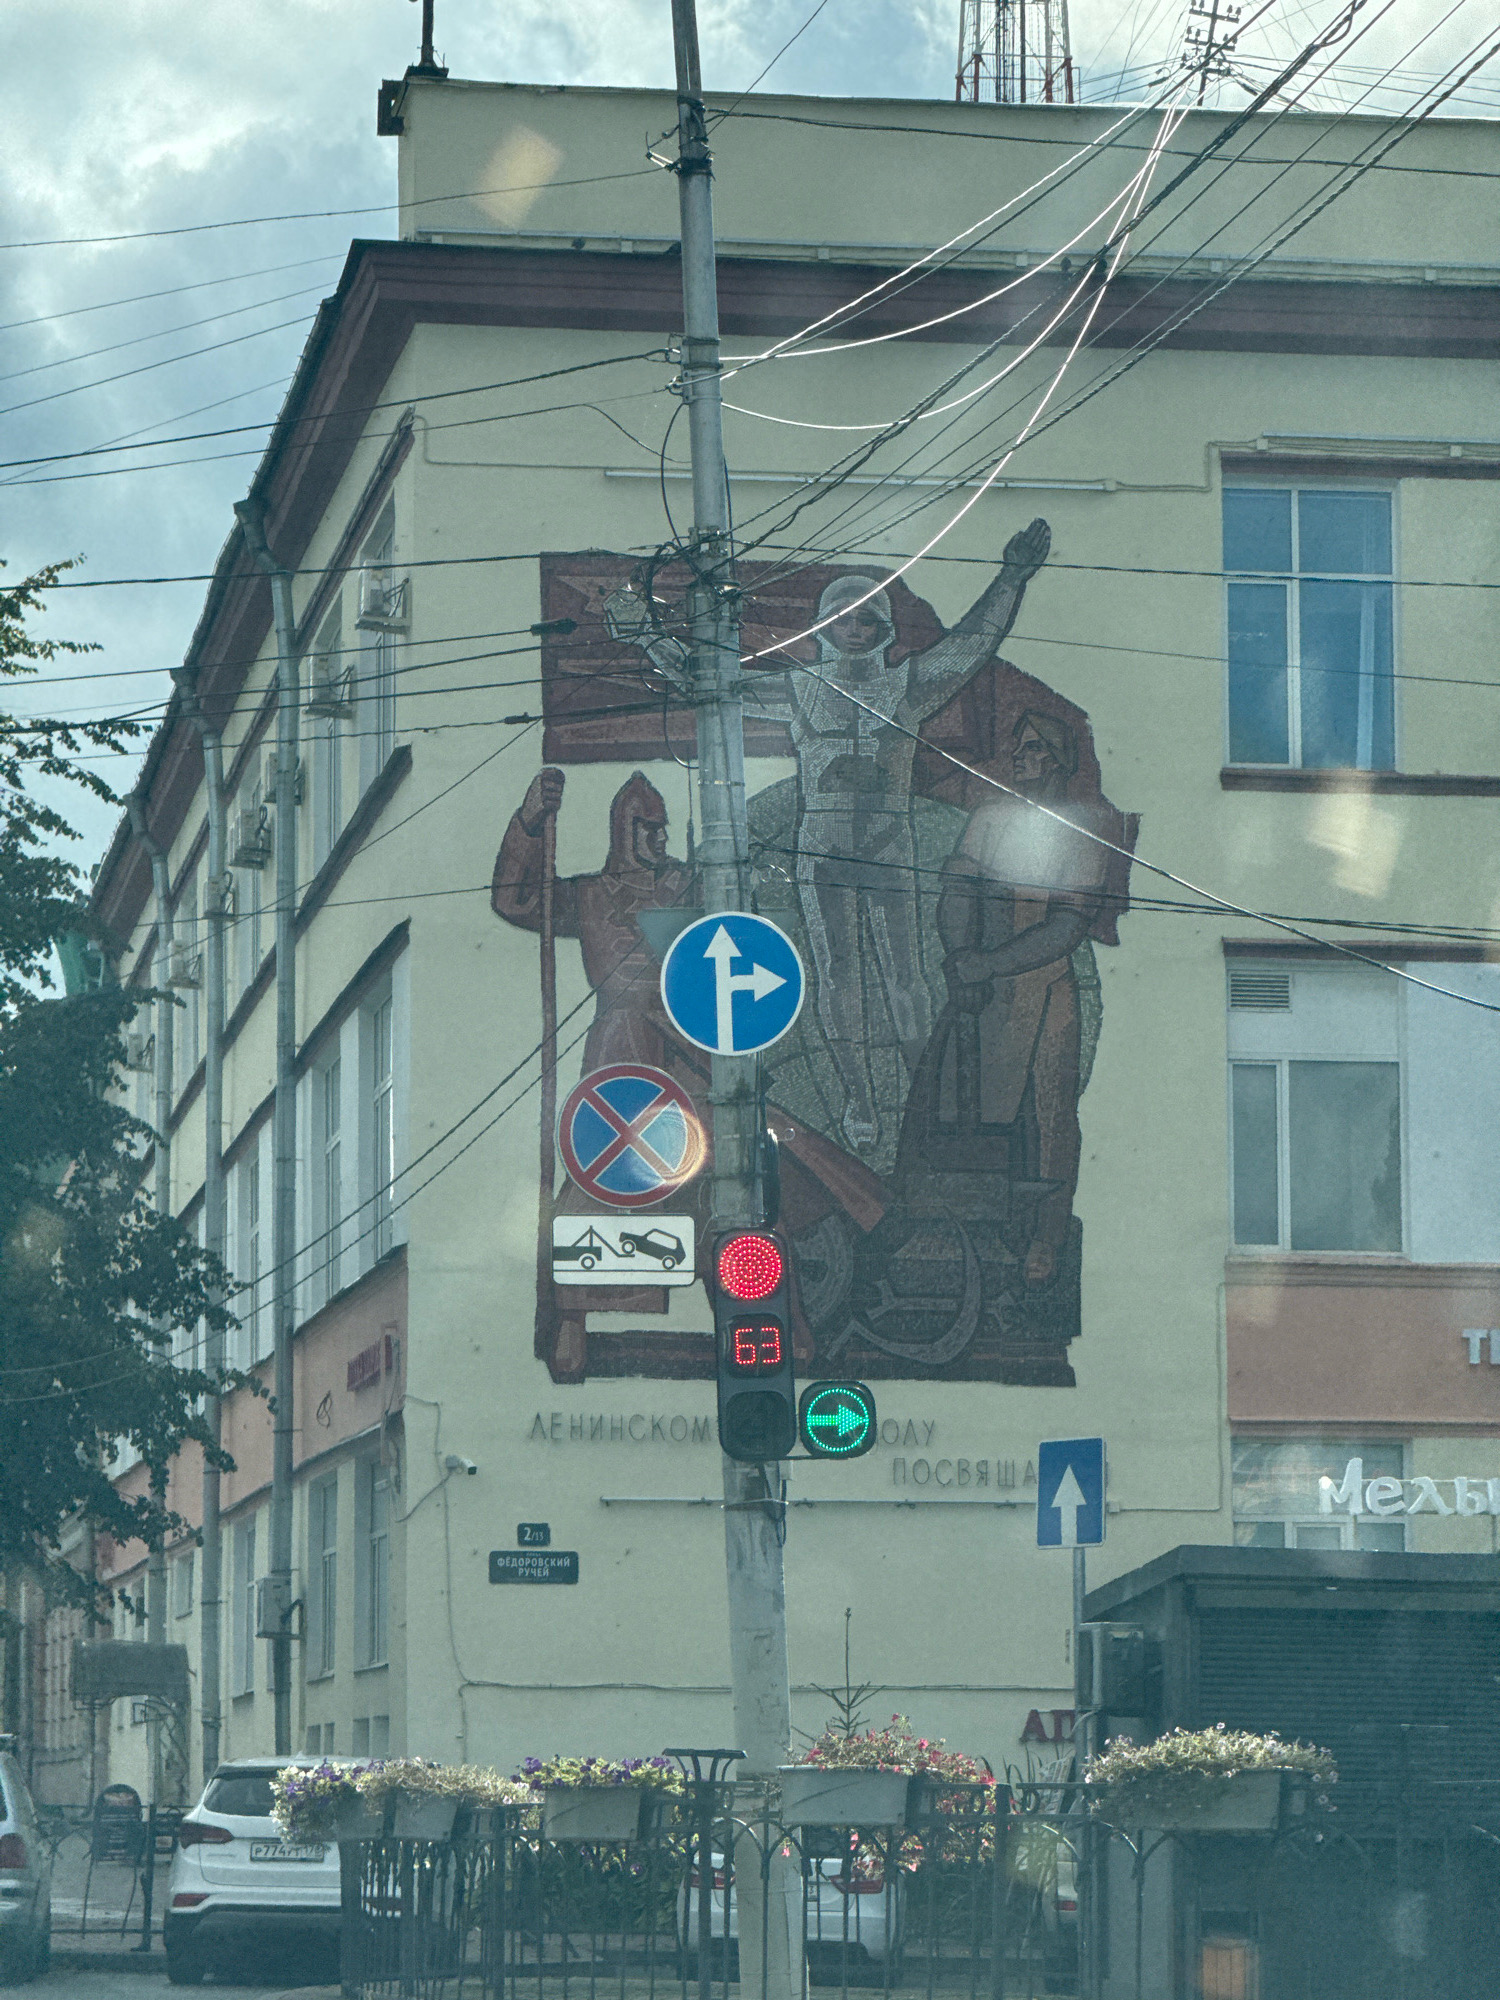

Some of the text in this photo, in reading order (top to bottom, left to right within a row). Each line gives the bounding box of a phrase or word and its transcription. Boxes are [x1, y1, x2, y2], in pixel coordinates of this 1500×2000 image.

[735, 1327, 781, 1364] 63
[530, 1411, 713, 1443] ЛЕНИНСКОМ
[892, 1457, 1038, 1488] ПОСВЯЩА
[523, 1526, 544, 1541] 2/13
[497, 1557, 570, 1568] ФЁДОРОВСКИЙ
[518, 1567, 549, 1577] РУЧЕЙ
